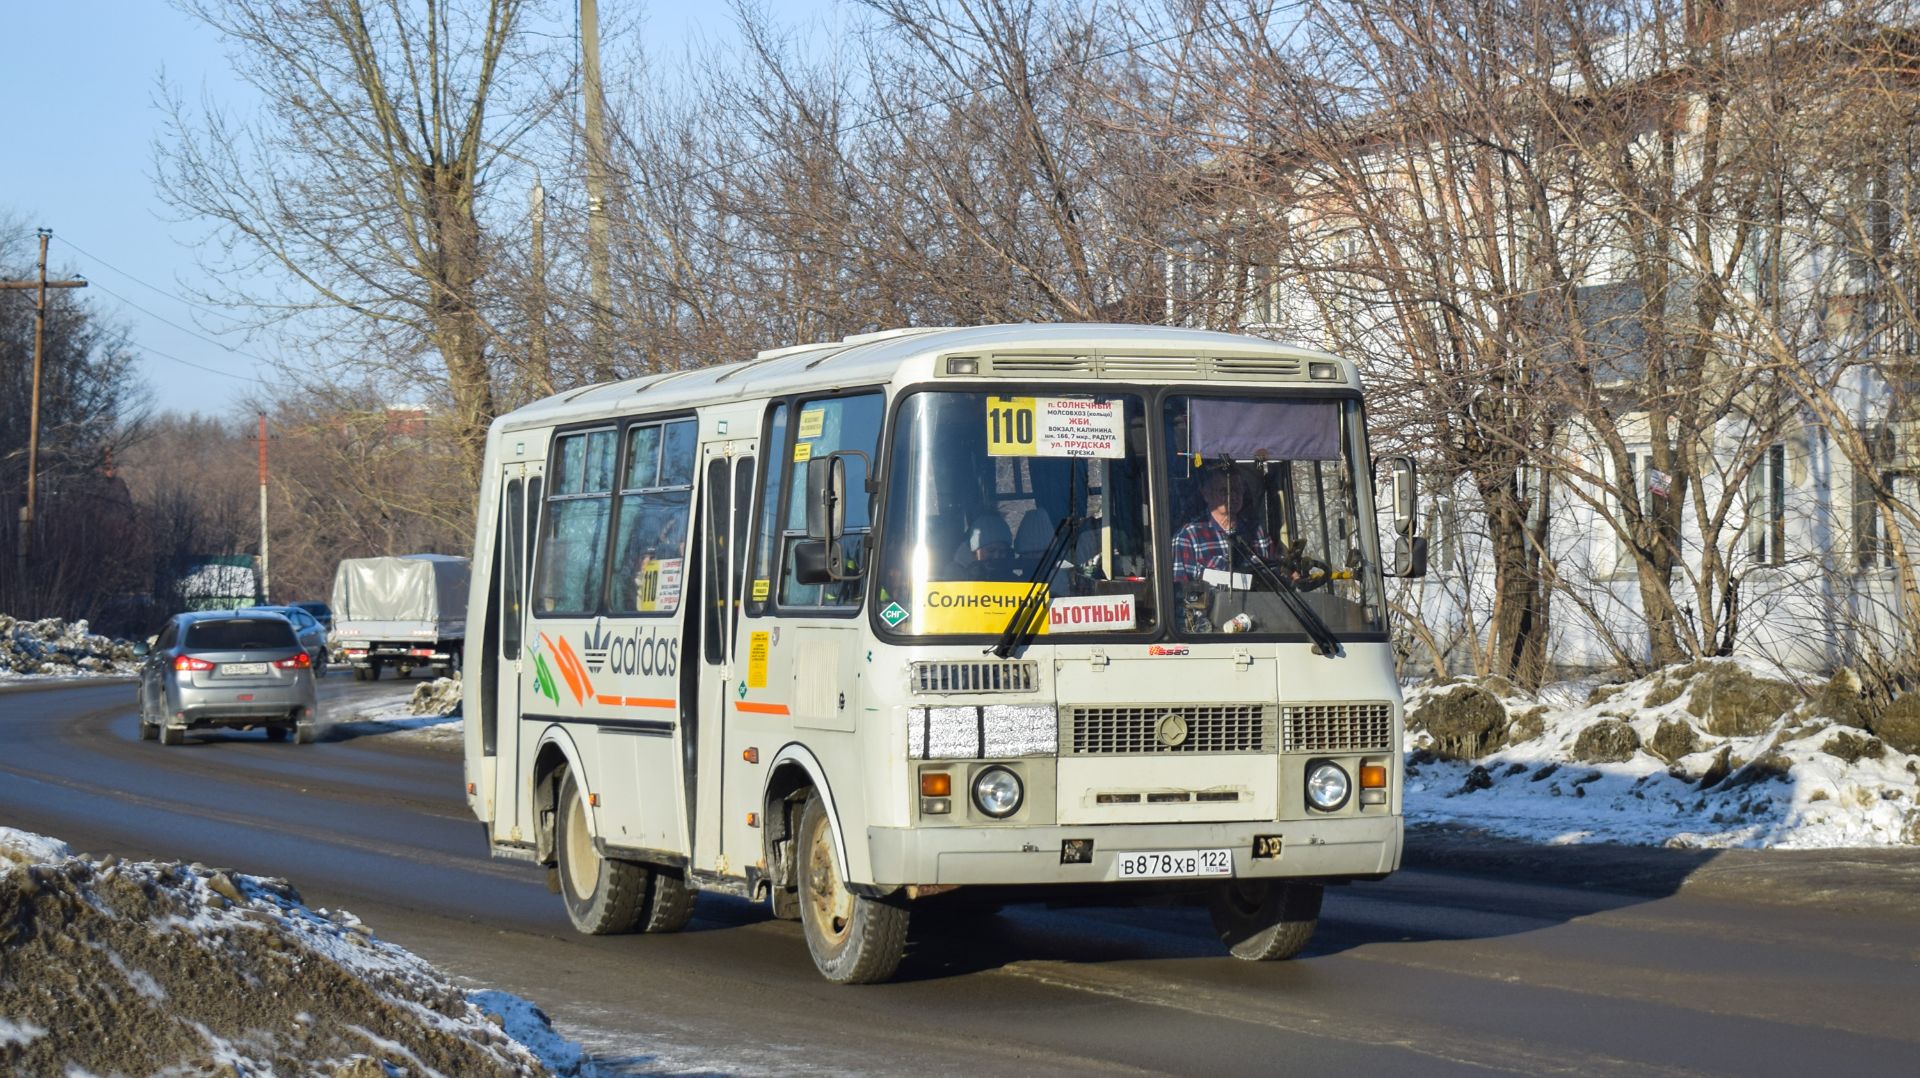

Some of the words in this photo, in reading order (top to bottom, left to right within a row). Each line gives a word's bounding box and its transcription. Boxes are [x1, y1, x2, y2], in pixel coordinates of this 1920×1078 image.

[990, 408, 1033, 444] 110
[1051, 441, 1063, 449] ул.
[1064, 440, 1111, 449] ПРУДСКАЯ
[885, 610, 902, 618] СНГ
[1048, 600, 1130, 624] ЬГОТНЫЙ
[610, 626, 678, 677] adidas
[1124, 854, 1196, 875] В878ХВ
[1200, 851, 1227, 867] 122
